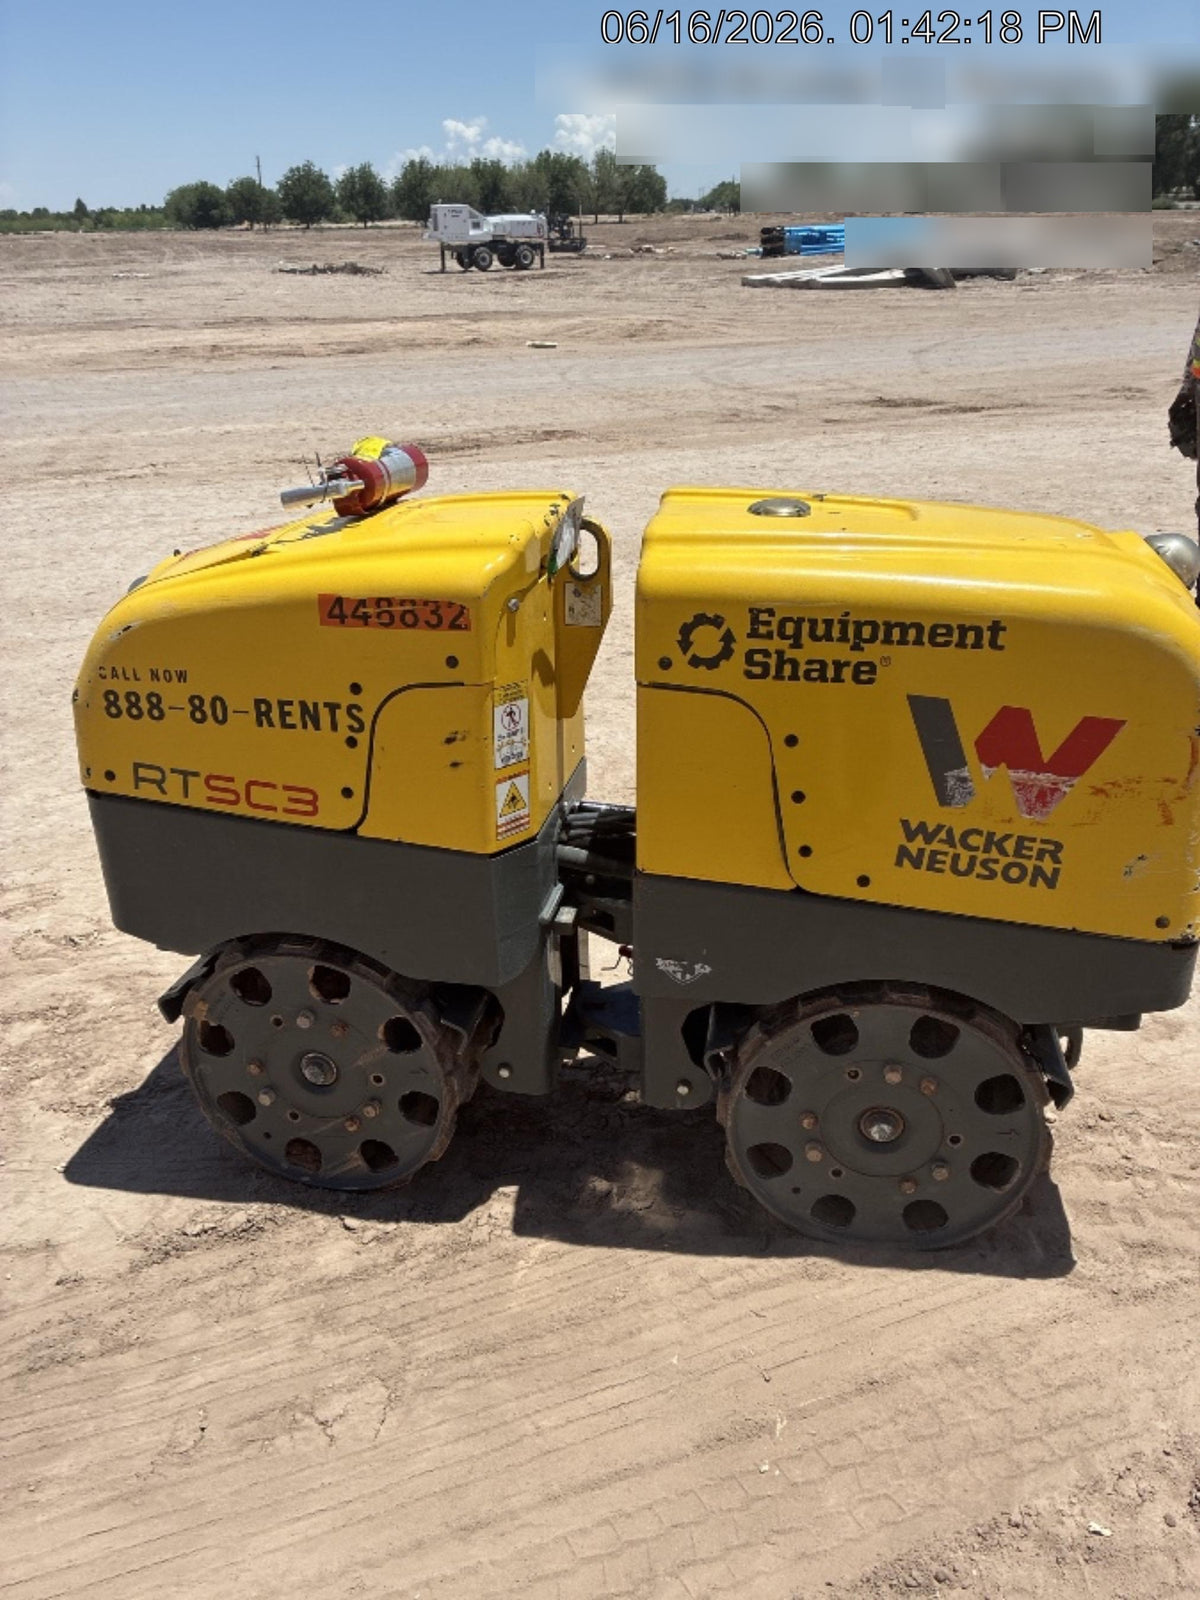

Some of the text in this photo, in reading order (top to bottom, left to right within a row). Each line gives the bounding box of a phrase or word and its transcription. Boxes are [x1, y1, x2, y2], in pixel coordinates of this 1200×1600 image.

[746, 607, 1006, 652] Equipment
[98, 666, 188, 683] CALL NOW
[104, 689, 365, 733] 888-80-RENTS
[900, 818, 1064, 864] WACKER
[894, 846, 1061, 889] NEUSON
